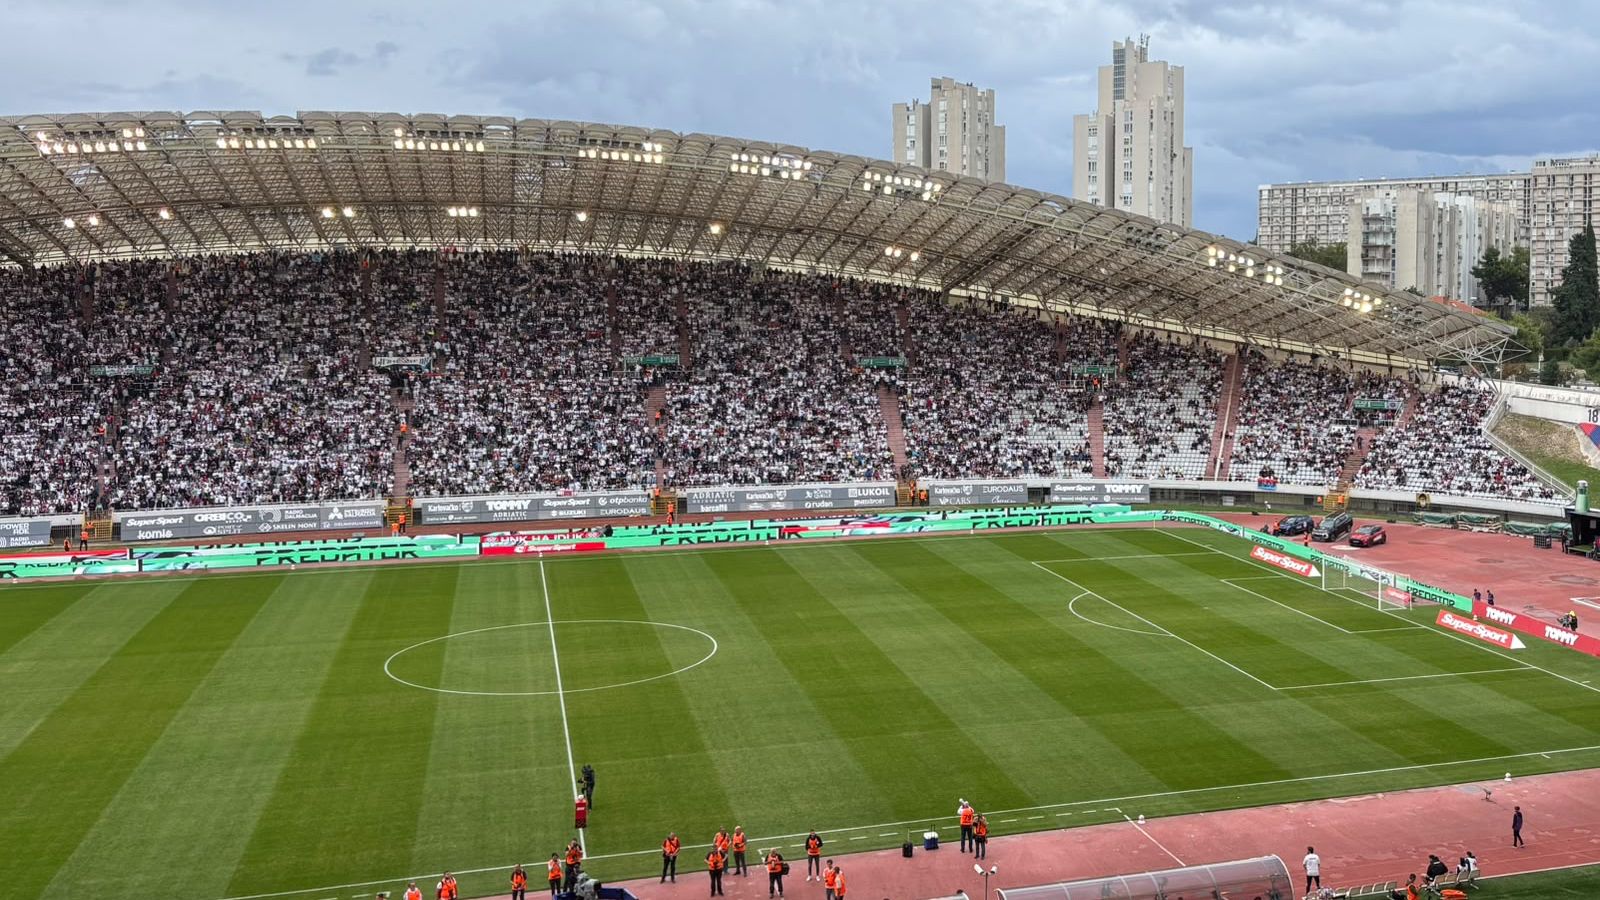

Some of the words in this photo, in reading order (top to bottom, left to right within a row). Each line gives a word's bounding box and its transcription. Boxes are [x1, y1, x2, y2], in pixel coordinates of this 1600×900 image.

[1588, 409, 1599, 423] 18
[858, 488, 890, 496] LUKOIL
[983, 485, 1024, 493] EURODAUS
[1054, 484, 1096, 492] SuperSport
[1104, 484, 1145, 493] TOMMY
[692, 491, 735, 499] ADRIATIC
[485, 500, 532, 511] TOMMY
[543, 498, 591, 507] SuperSport
[812, 500, 833, 508] rudan
[126, 516, 185, 527] SuperSport
[194, 512, 245, 522] ORBICO
[1254, 547, 1310, 573] SuperSport
[1486, 606, 1517, 625] TOMMY
[1441, 613, 1509, 644] SuperSport
[1545, 625, 1579, 646] TOMMY
